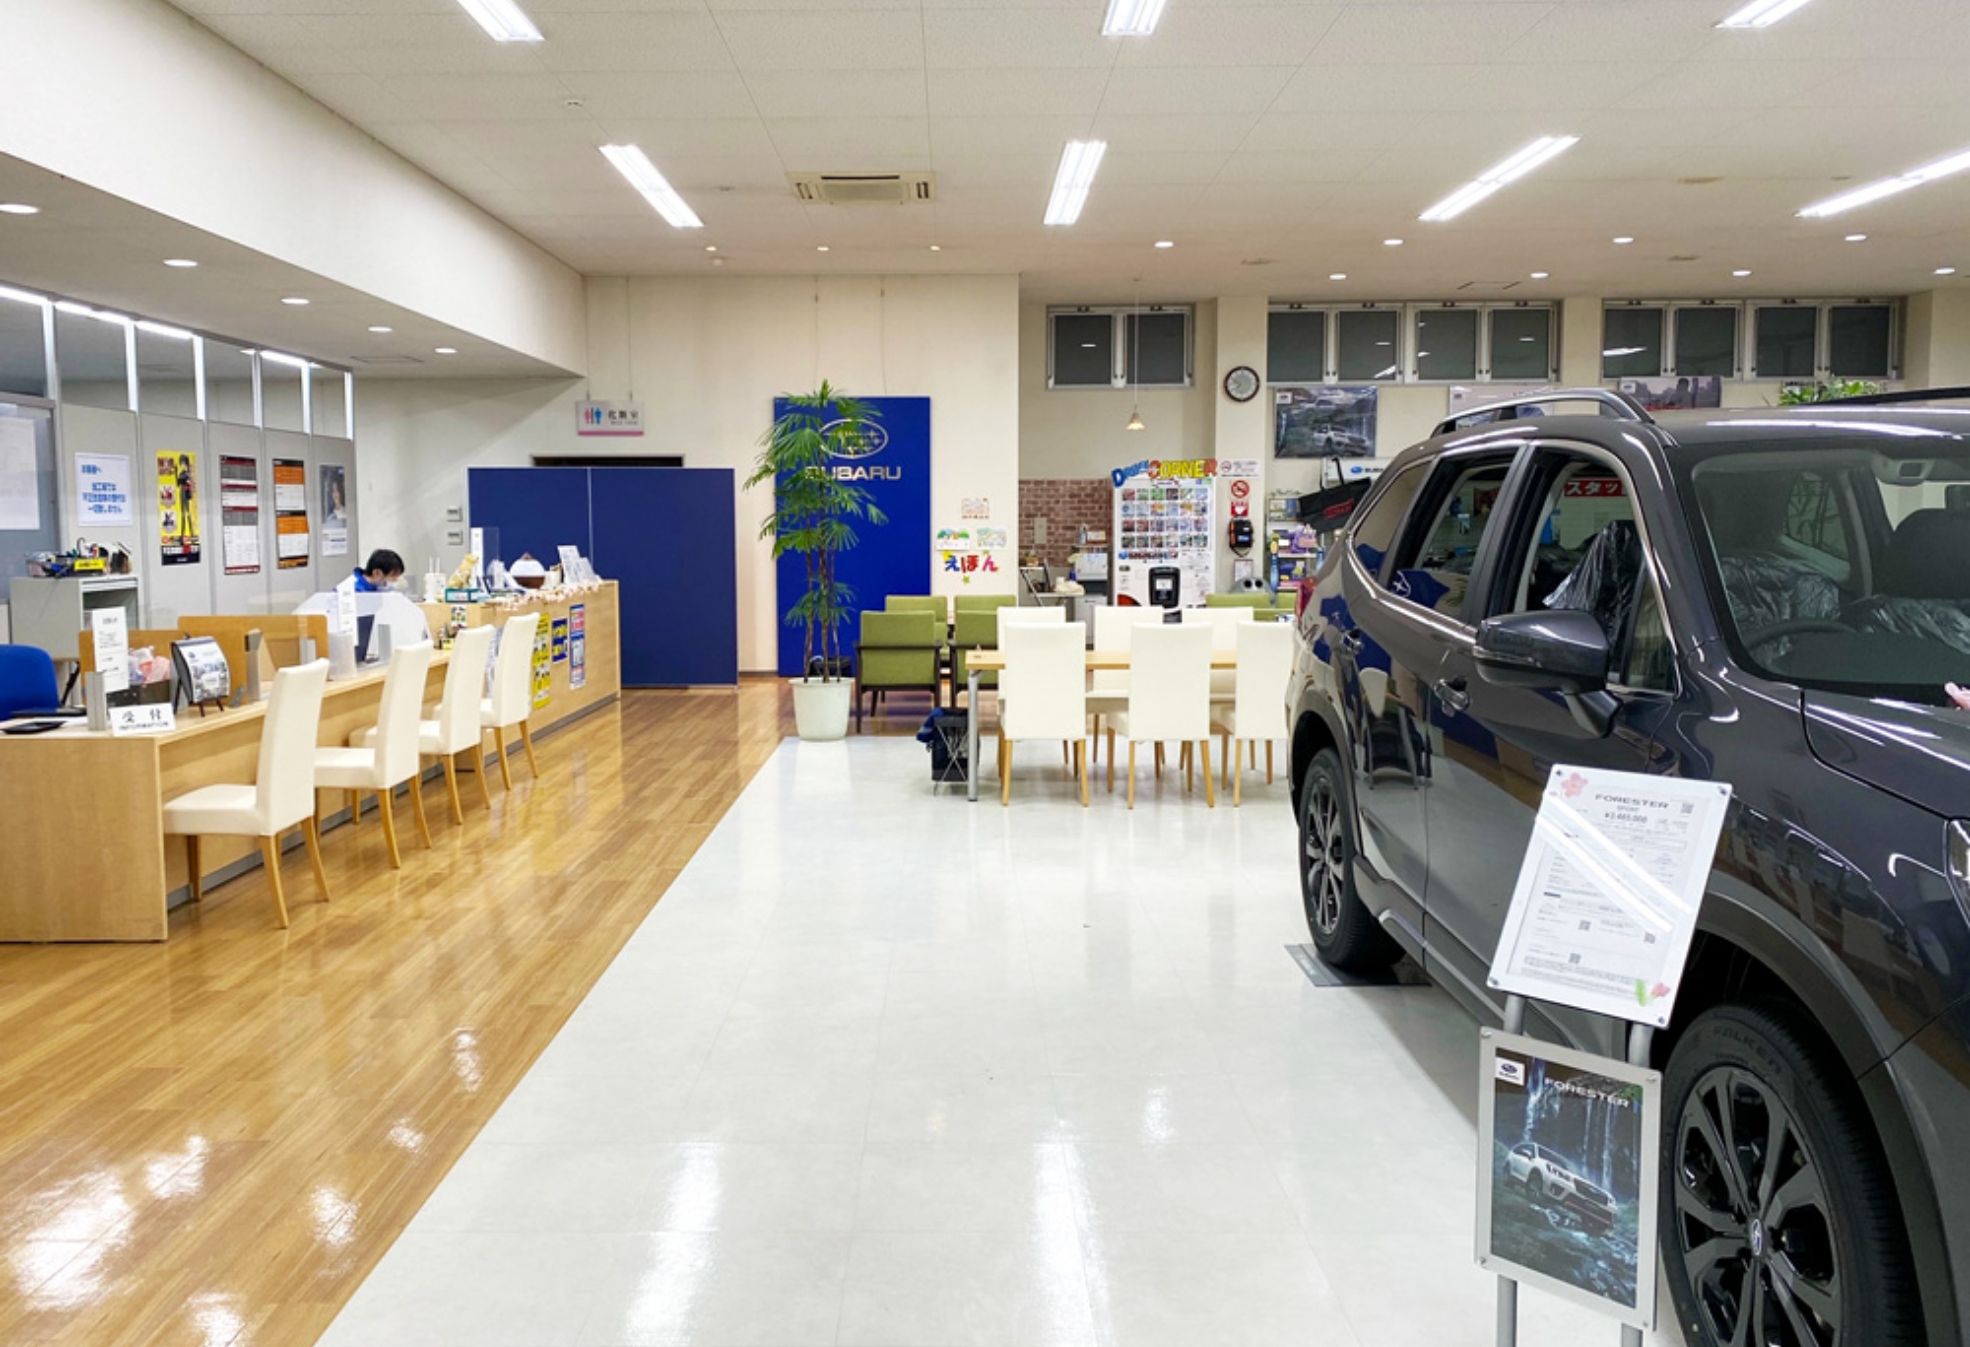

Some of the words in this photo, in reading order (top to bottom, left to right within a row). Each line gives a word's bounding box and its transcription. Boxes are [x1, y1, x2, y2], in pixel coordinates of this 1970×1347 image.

[805, 466, 901, 480] SUBARU
[1566, 481, 1625, 496] スタッ
[944, 554, 999, 573] えほん
[1595, 793, 1669, 809] FORESTER
[1544, 1077, 1629, 1108] FORESTER
